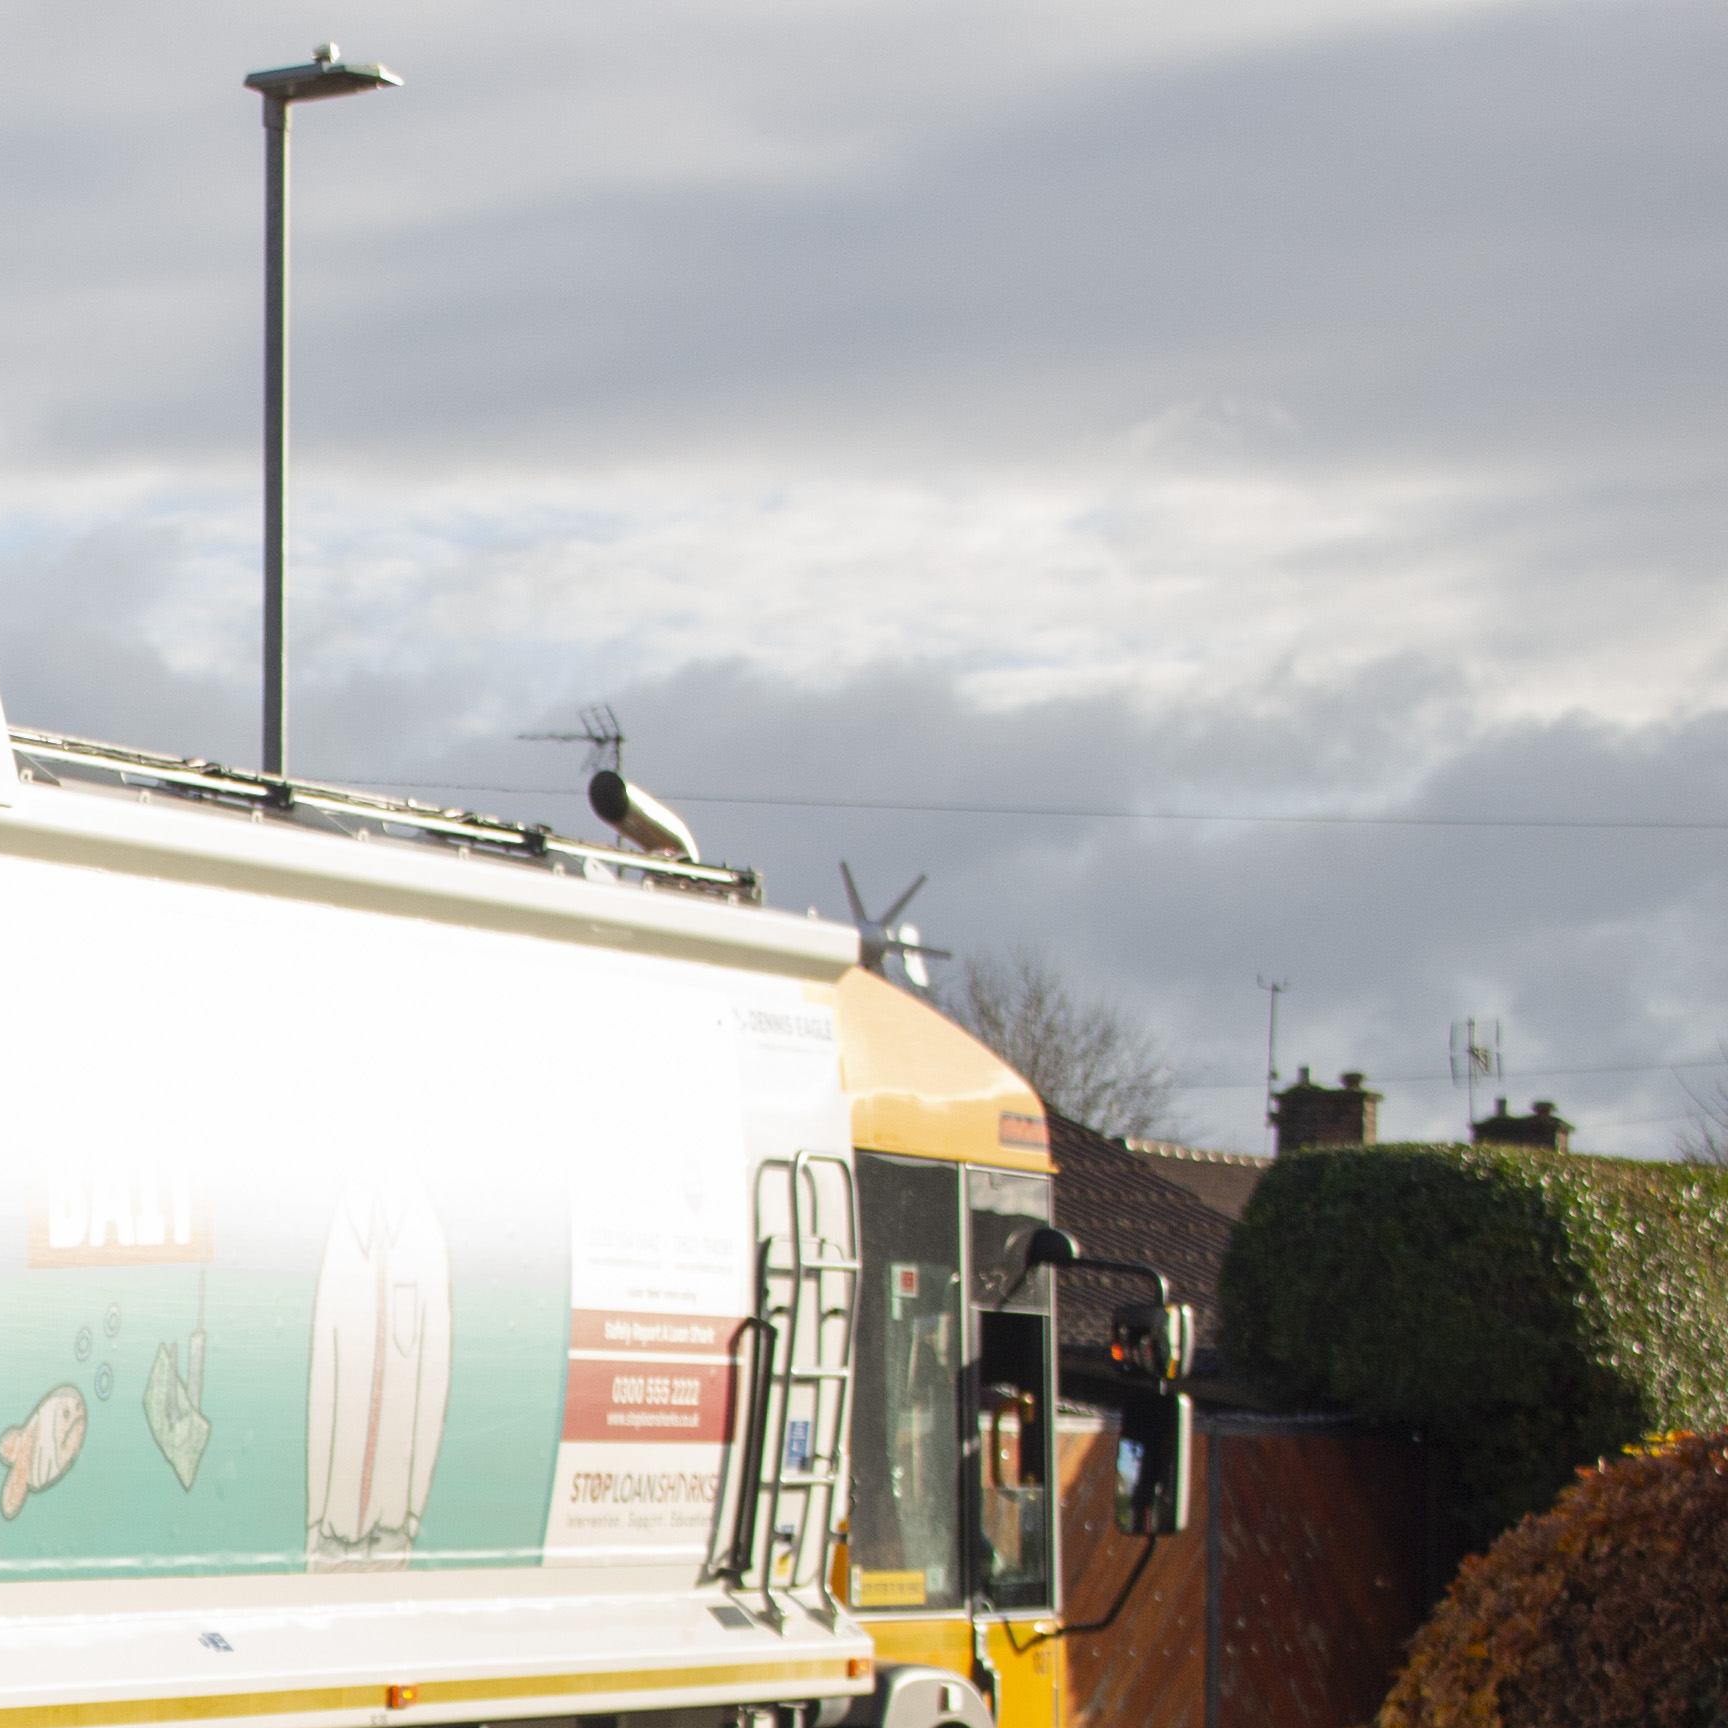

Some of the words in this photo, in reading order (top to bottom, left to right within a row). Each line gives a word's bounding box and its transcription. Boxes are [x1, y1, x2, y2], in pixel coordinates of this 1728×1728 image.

[612, 1375, 645, 1404] 0300
[645, 1376, 671, 1405] 555
[670, 1378, 702, 1407] 2222
